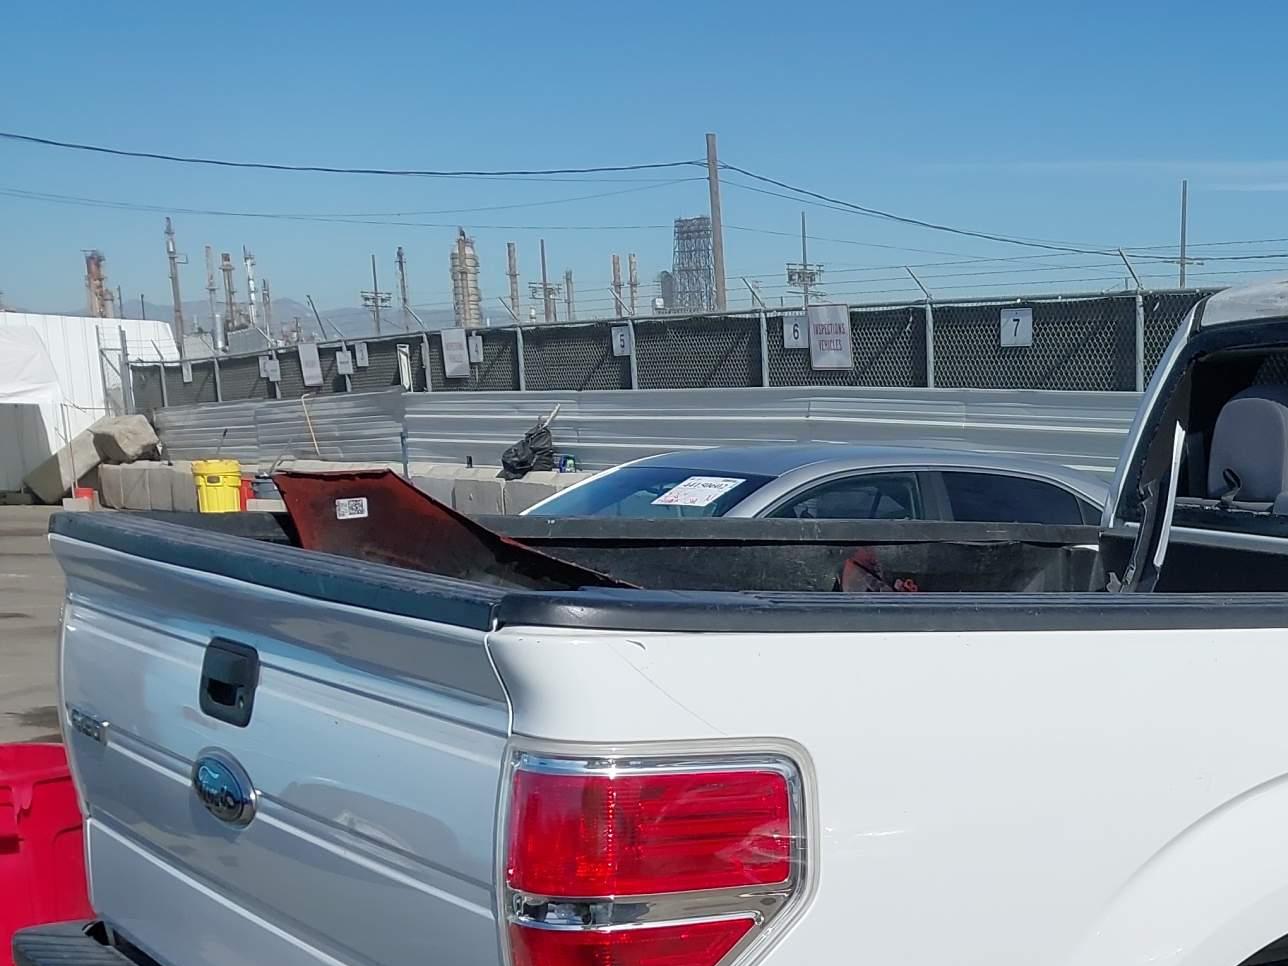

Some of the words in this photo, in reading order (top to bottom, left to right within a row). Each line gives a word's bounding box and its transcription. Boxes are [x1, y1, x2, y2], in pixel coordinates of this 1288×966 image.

[792, 323, 800, 341] 6
[1012, 318, 1020, 337] 7
[619, 334, 625, 348] 5
